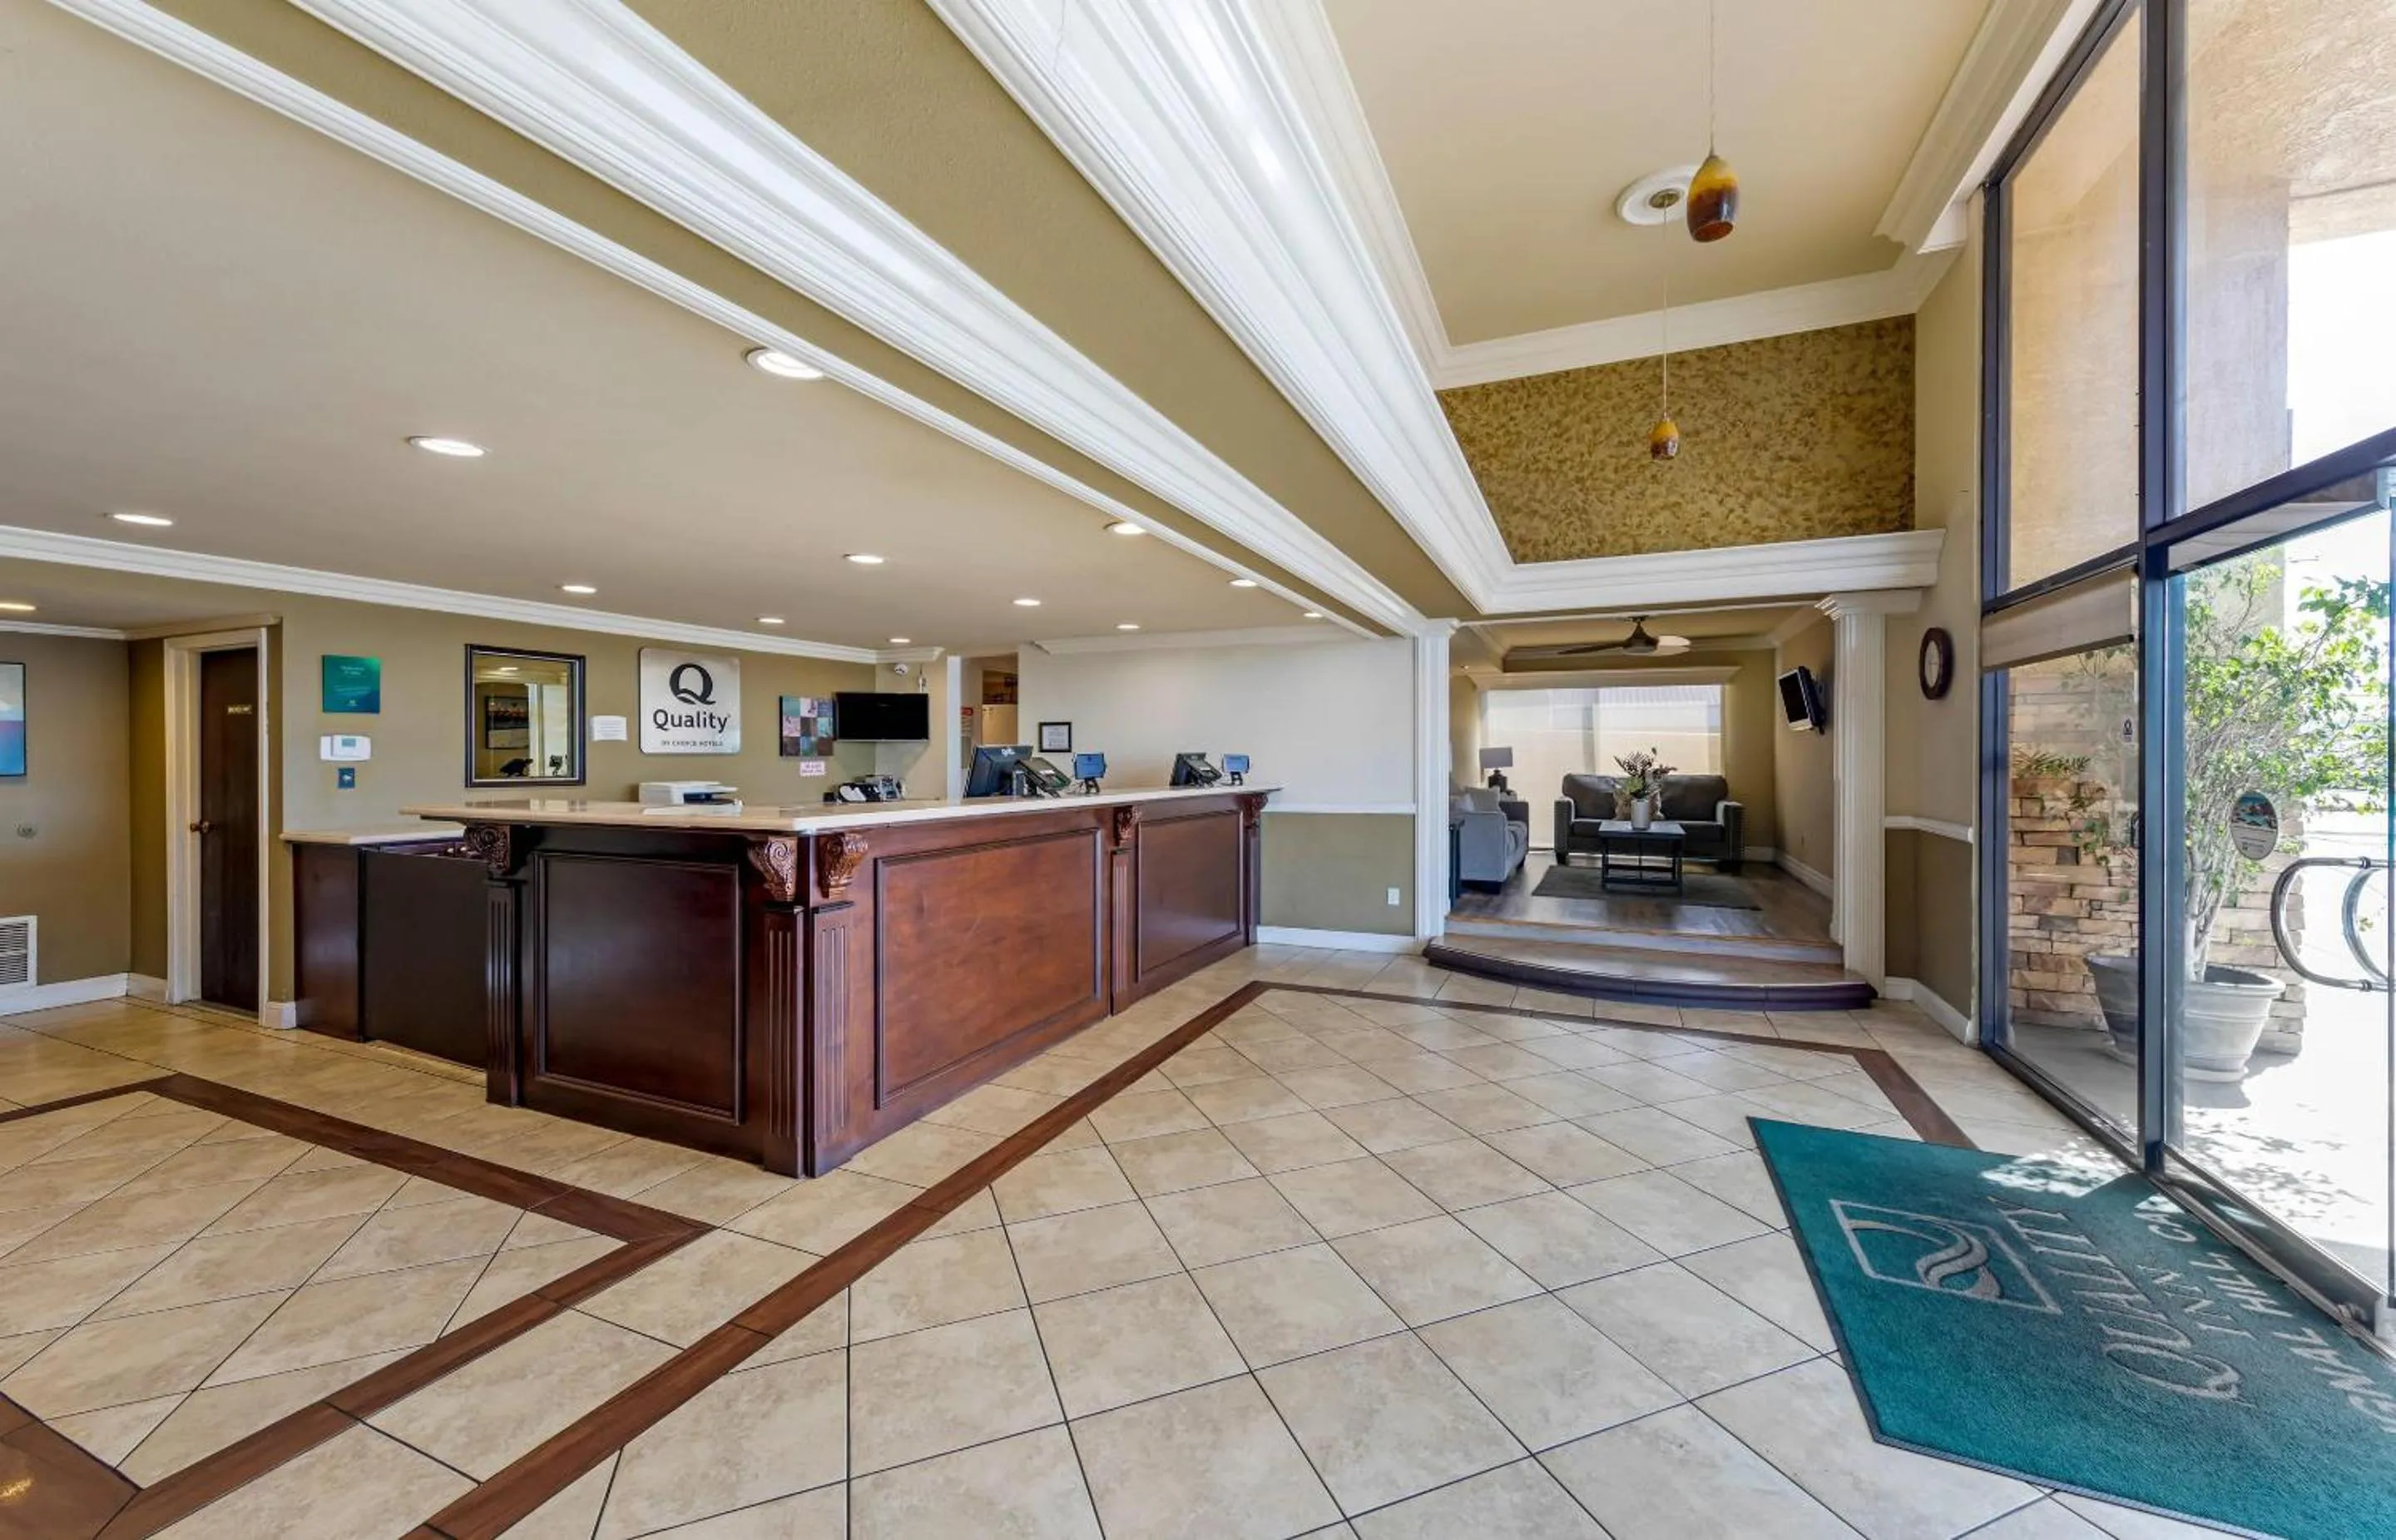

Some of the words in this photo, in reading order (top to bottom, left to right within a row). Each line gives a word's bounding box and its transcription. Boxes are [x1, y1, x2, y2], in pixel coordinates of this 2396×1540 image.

[652, 709, 727, 734] Quality
[669, 663, 716, 705] Q
[1987, 1196, 2256, 1408] QUALITY
[2137, 1264, 2257, 1341] INN
[2271, 1326, 2396, 1434] GNAL
